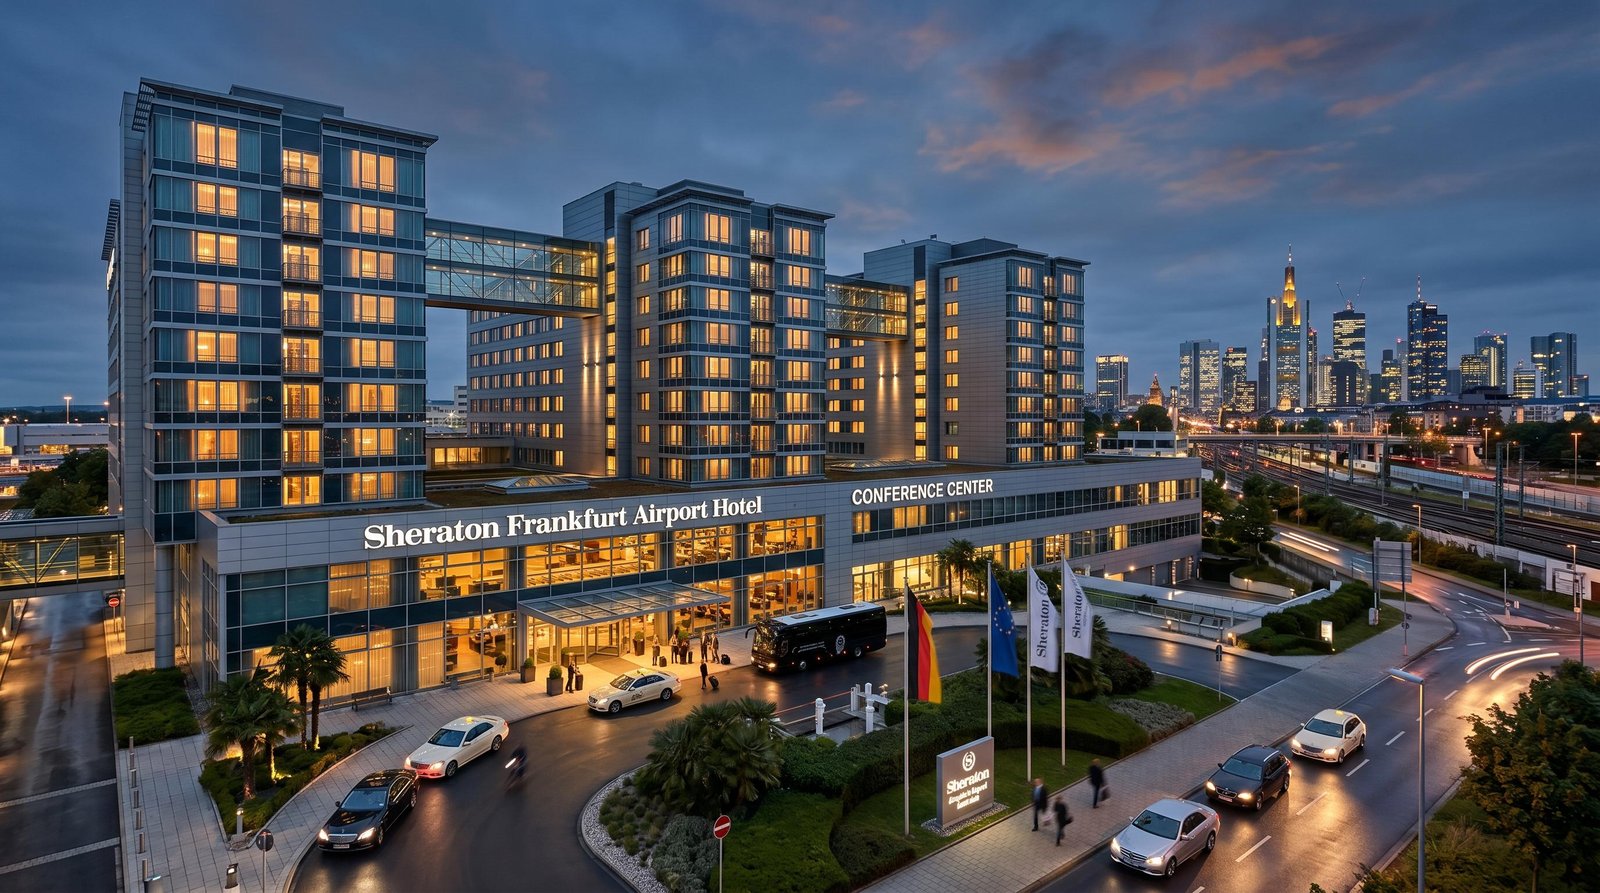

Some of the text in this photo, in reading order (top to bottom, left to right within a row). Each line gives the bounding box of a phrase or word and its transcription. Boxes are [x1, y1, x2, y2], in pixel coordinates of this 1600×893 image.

[852, 479, 993, 504] CONFERENCE CENTER
[364, 496, 762, 550] Sheraton Frankfurt Airport Hotel
[1037, 600, 1049, 657] Sheraton
[947, 769, 989, 794] Sheraton
